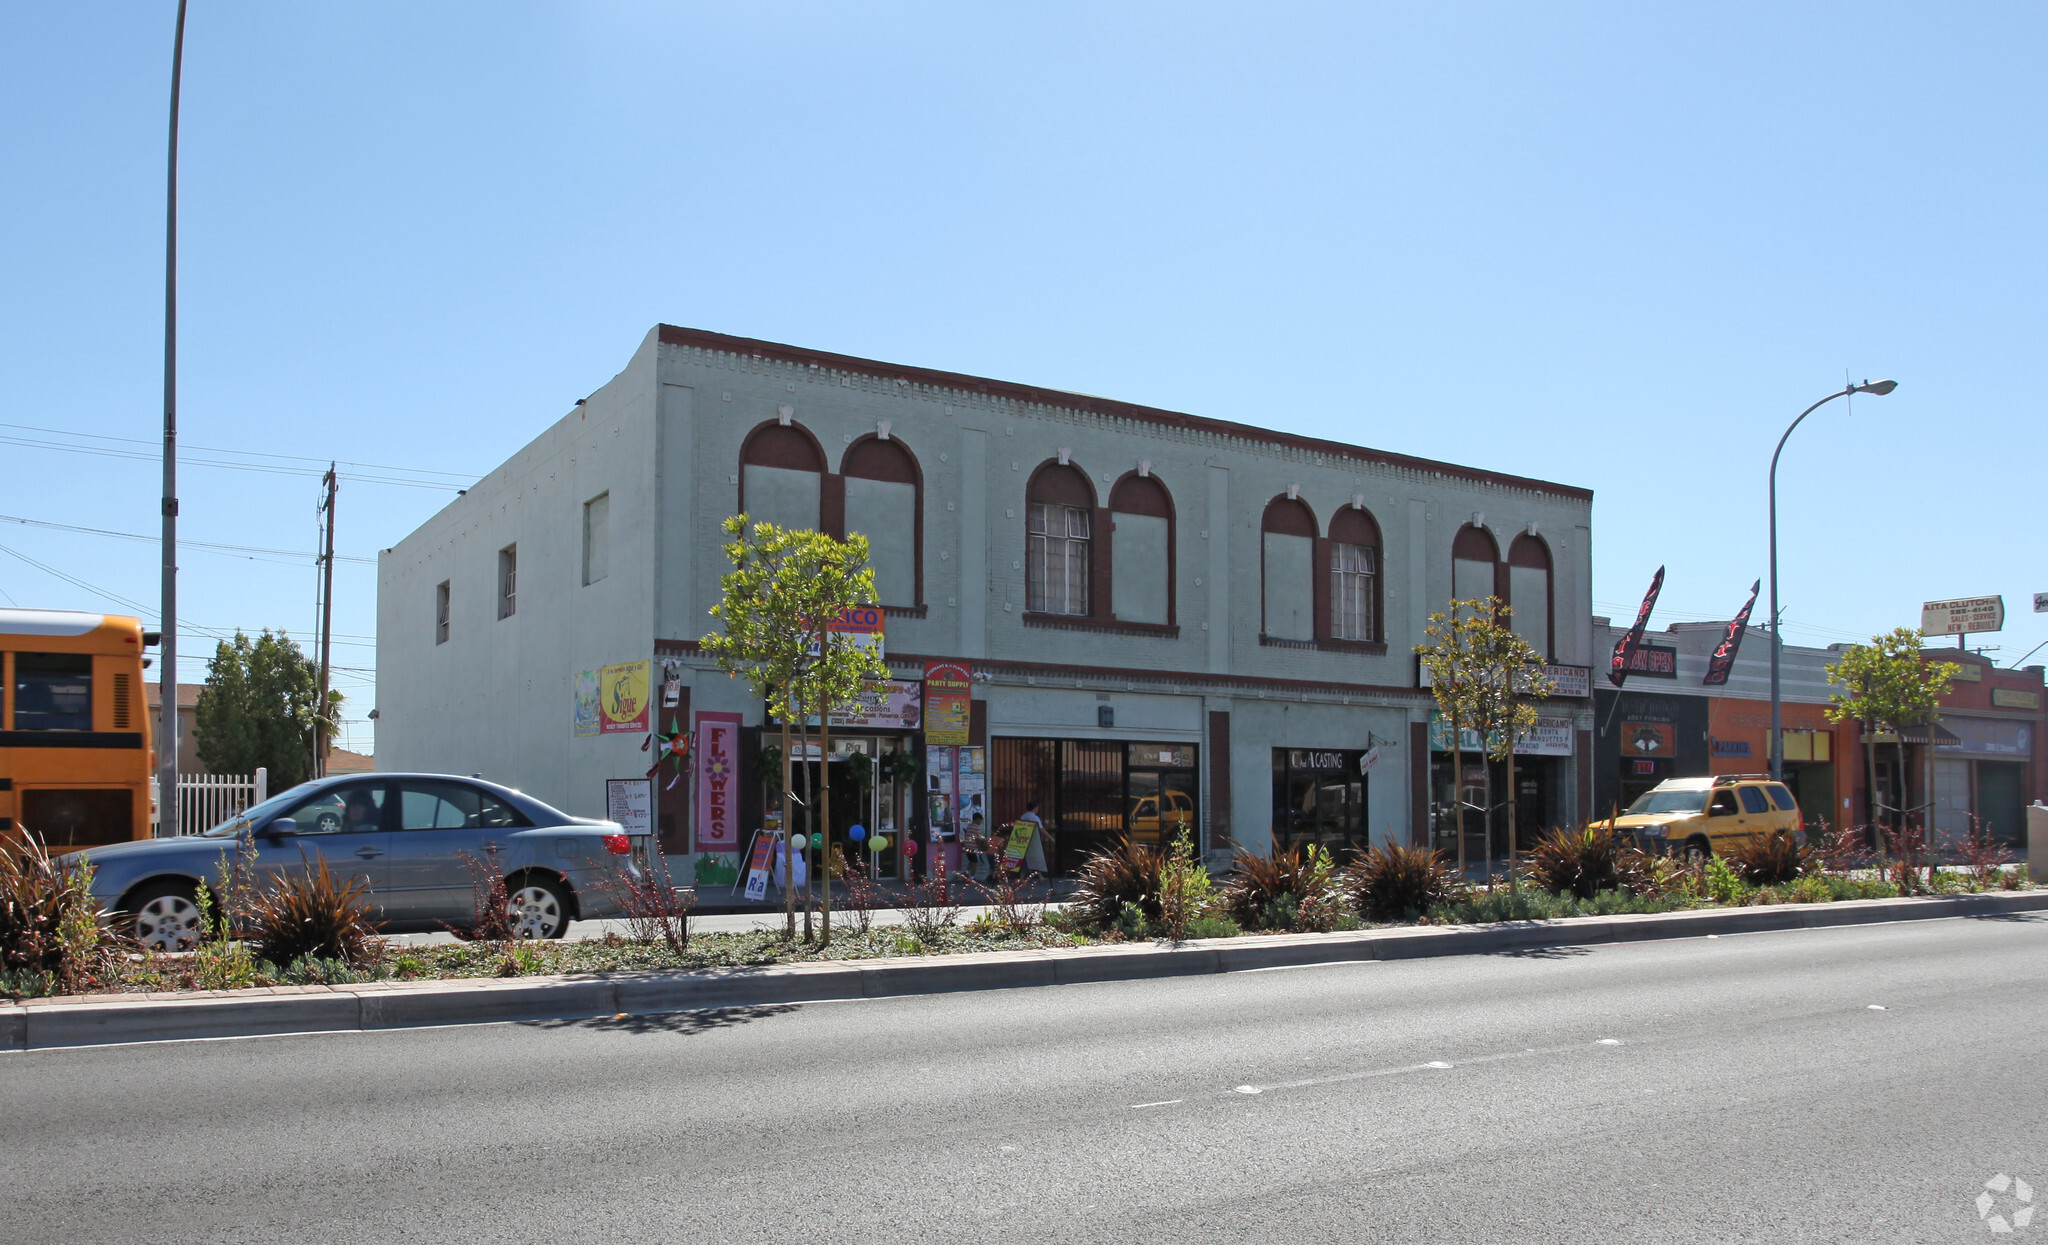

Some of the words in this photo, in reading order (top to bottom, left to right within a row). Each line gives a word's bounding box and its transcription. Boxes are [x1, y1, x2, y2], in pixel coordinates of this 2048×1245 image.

[1949, 599, 1990, 609] CLUTCH
[1950, 615, 1969, 623] SALES
[1972, 612, 1996, 621] SERVICE
[1947, 623, 1961, 632] NEW
[1967, 620, 1996, 631] REBUILT
[1648, 650, 1674, 673] OPEN
[927, 679, 946, 687] PARTY
[611, 680, 637, 720] Sigue
[1718, 741, 1751, 752] PARKING
[1315, 752, 1343, 769] CASTING
